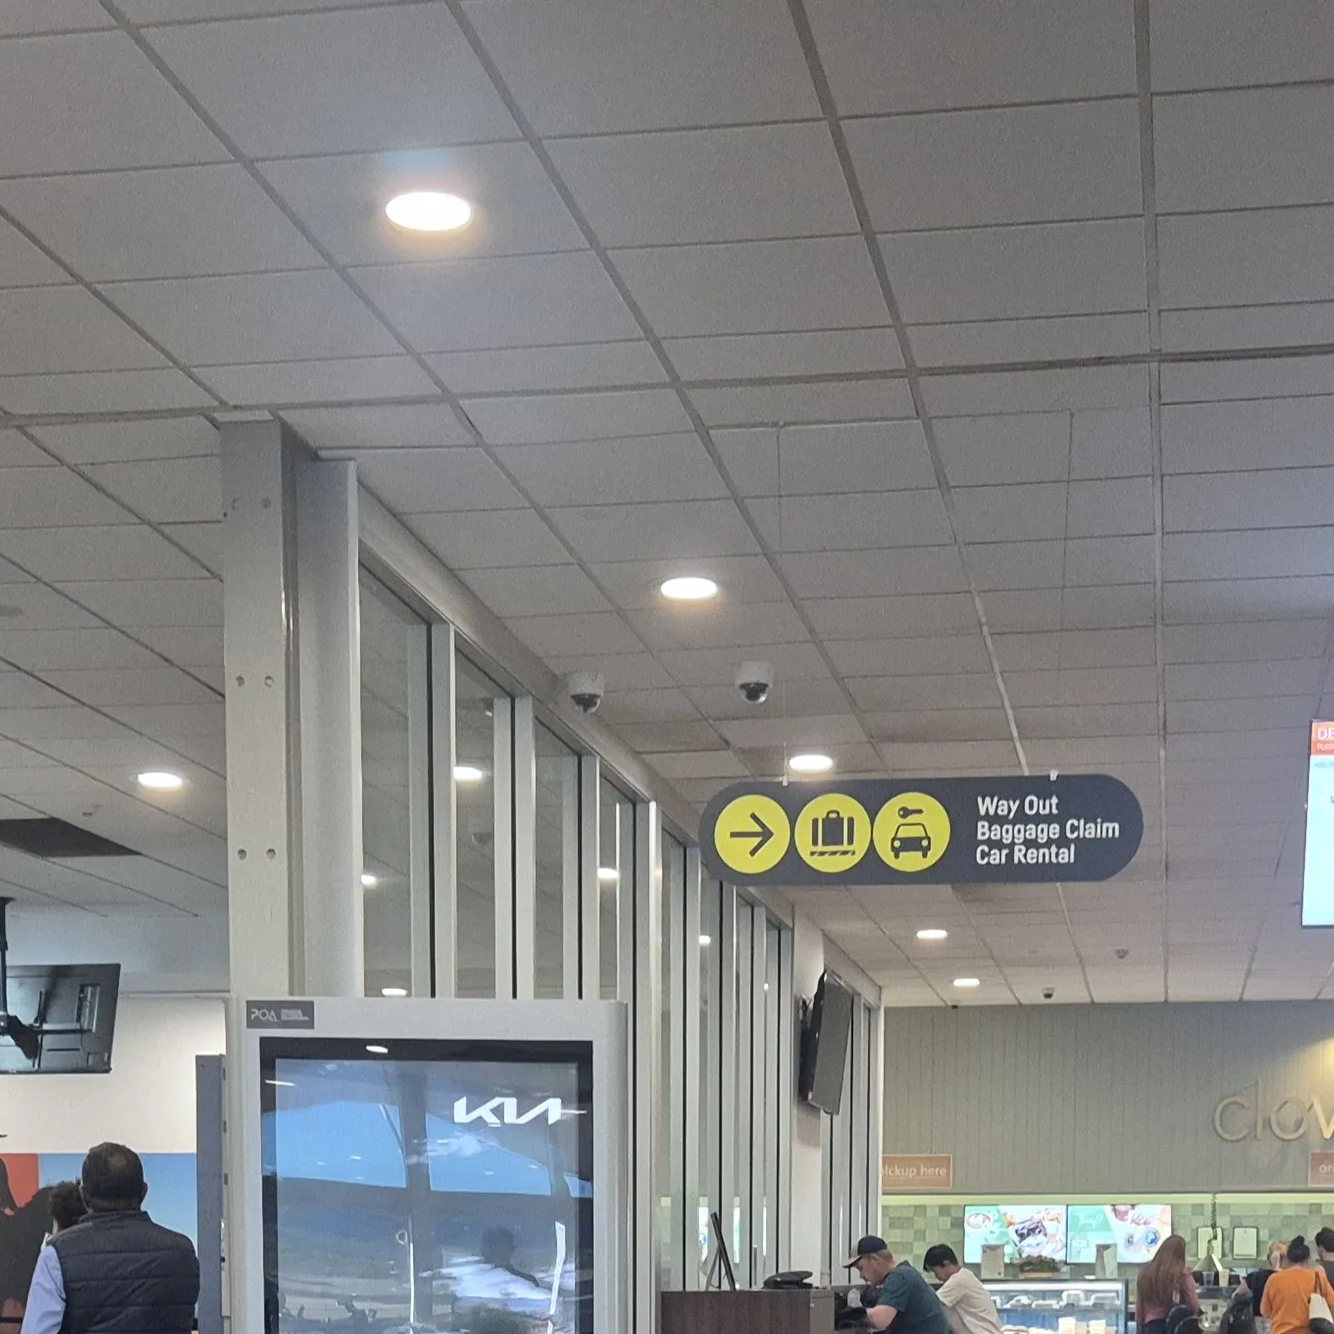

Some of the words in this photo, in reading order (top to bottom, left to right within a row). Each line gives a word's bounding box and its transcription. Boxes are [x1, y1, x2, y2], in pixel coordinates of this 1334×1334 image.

[977, 796, 1020, 819] Way
[1024, 794, 1058, 815] Out
[977, 820, 1060, 844] Baggage
[1066, 818, 1119, 839] Claim
[976, 844, 1009, 864] Car
[1013, 843, 1075, 864] Rental
[251, 1008, 277, 1022] POA
[920, 1164, 947, 1176] here
